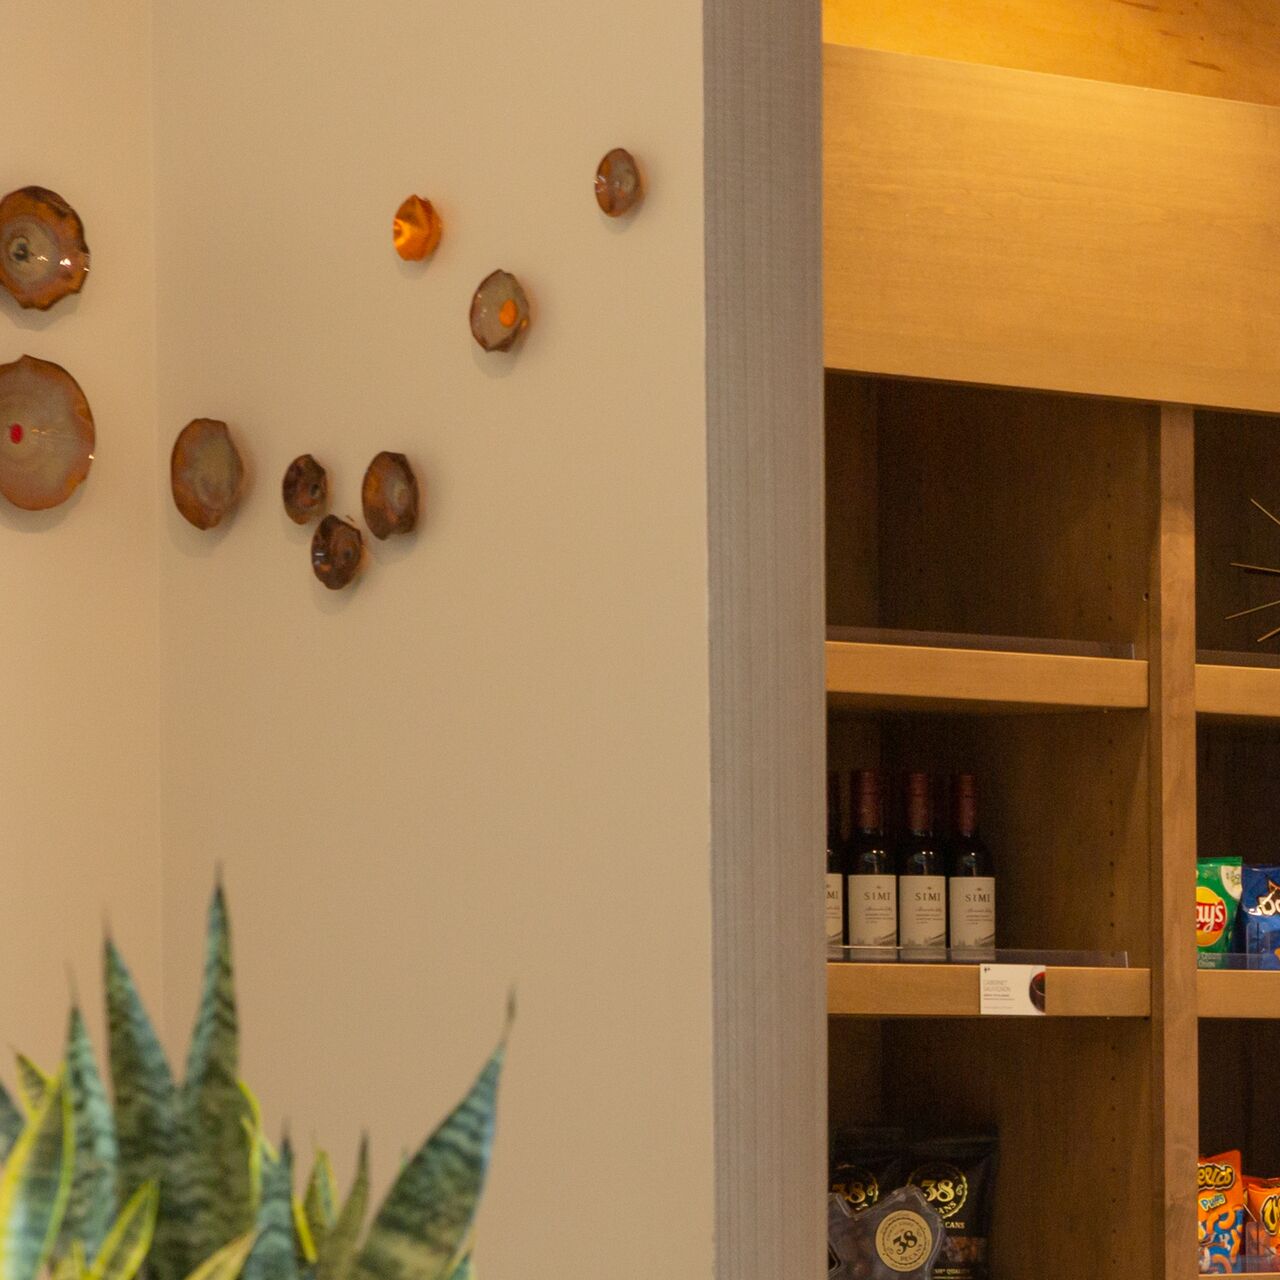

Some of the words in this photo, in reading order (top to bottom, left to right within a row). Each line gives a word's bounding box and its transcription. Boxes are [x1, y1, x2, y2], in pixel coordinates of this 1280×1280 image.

[827, 891, 838, 900] MI
[864, 892, 891, 901] SIMI
[915, 892, 941, 901] SIMI
[965, 893, 990, 902] SIMI
[1197, 903, 1223, 932] ay's
[921, 1180, 955, 1202] 38
[893, 1230, 917, 1255] 38
